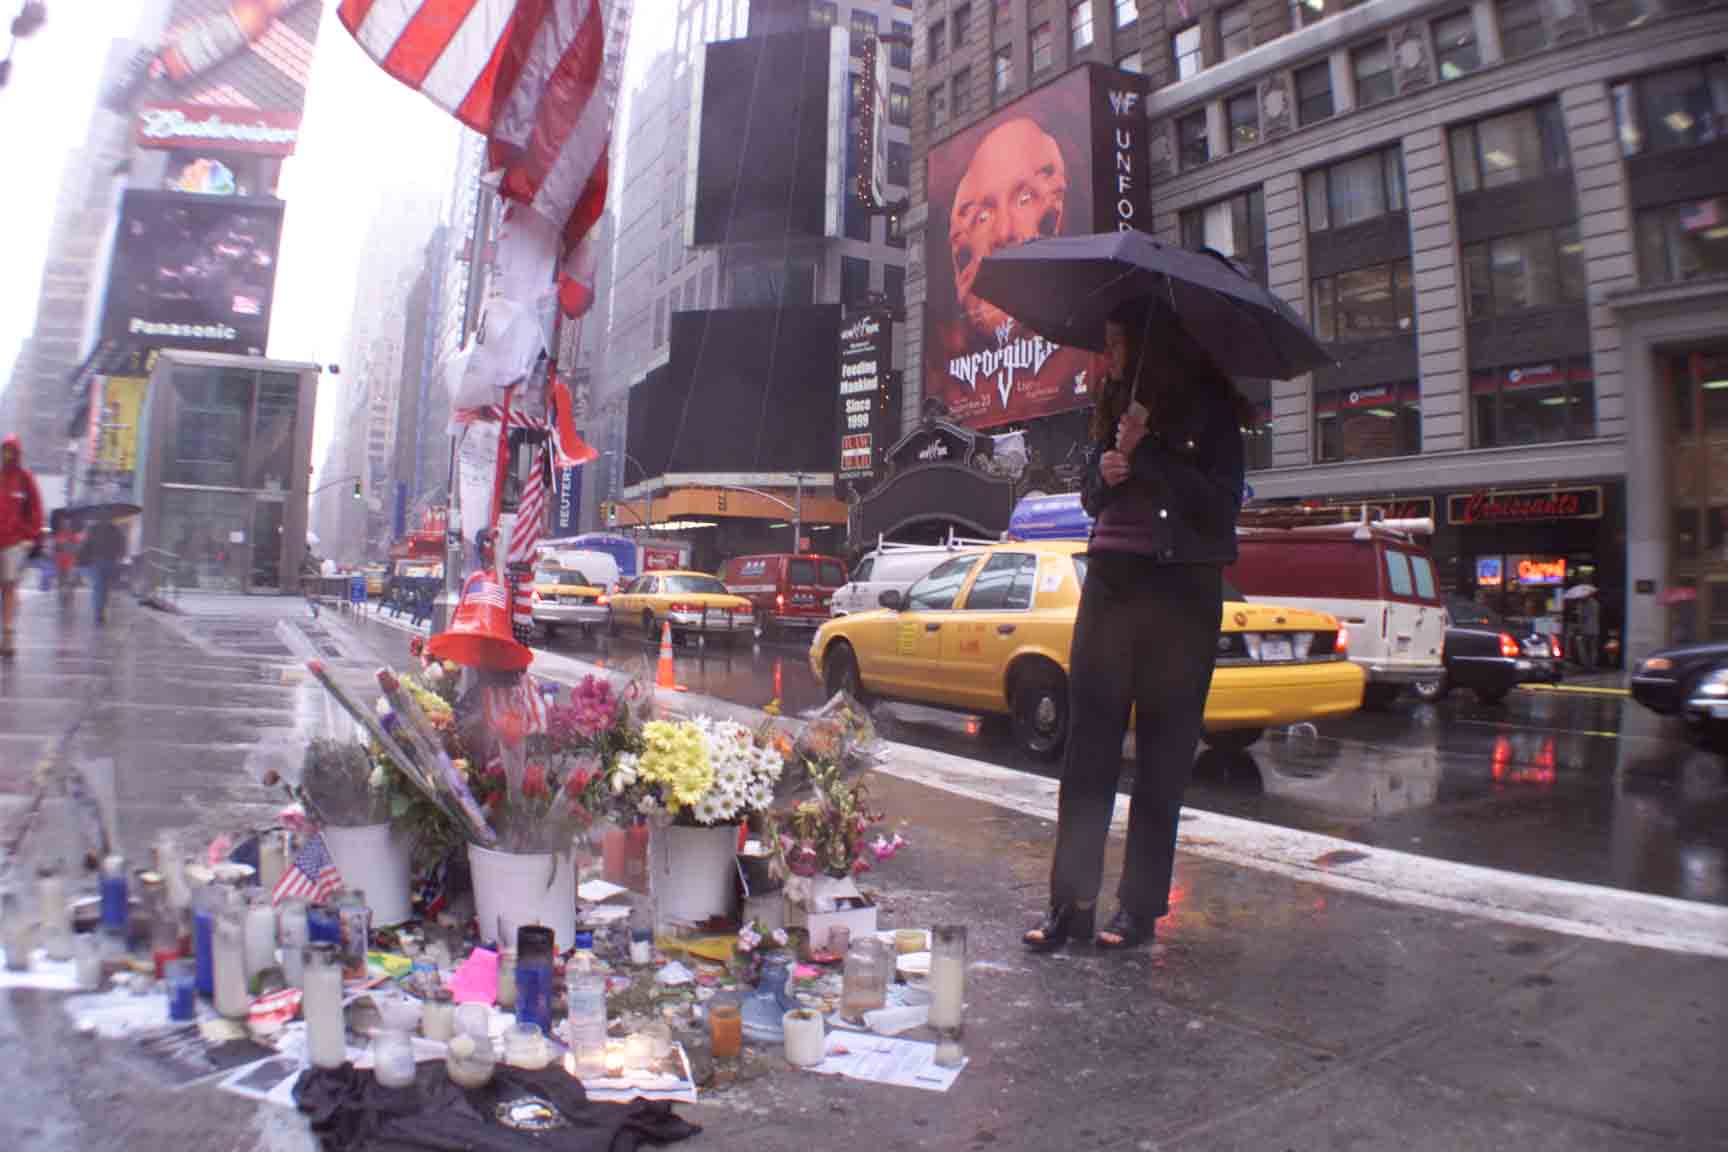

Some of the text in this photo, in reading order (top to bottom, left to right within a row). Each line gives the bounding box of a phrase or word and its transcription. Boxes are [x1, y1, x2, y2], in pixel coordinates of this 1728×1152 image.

[129, 318, 238, 340] Panasonic
[841, 360, 877, 379] Feeding
[840, 375, 879, 394] Mankind
[845, 397, 872, 414] Since
